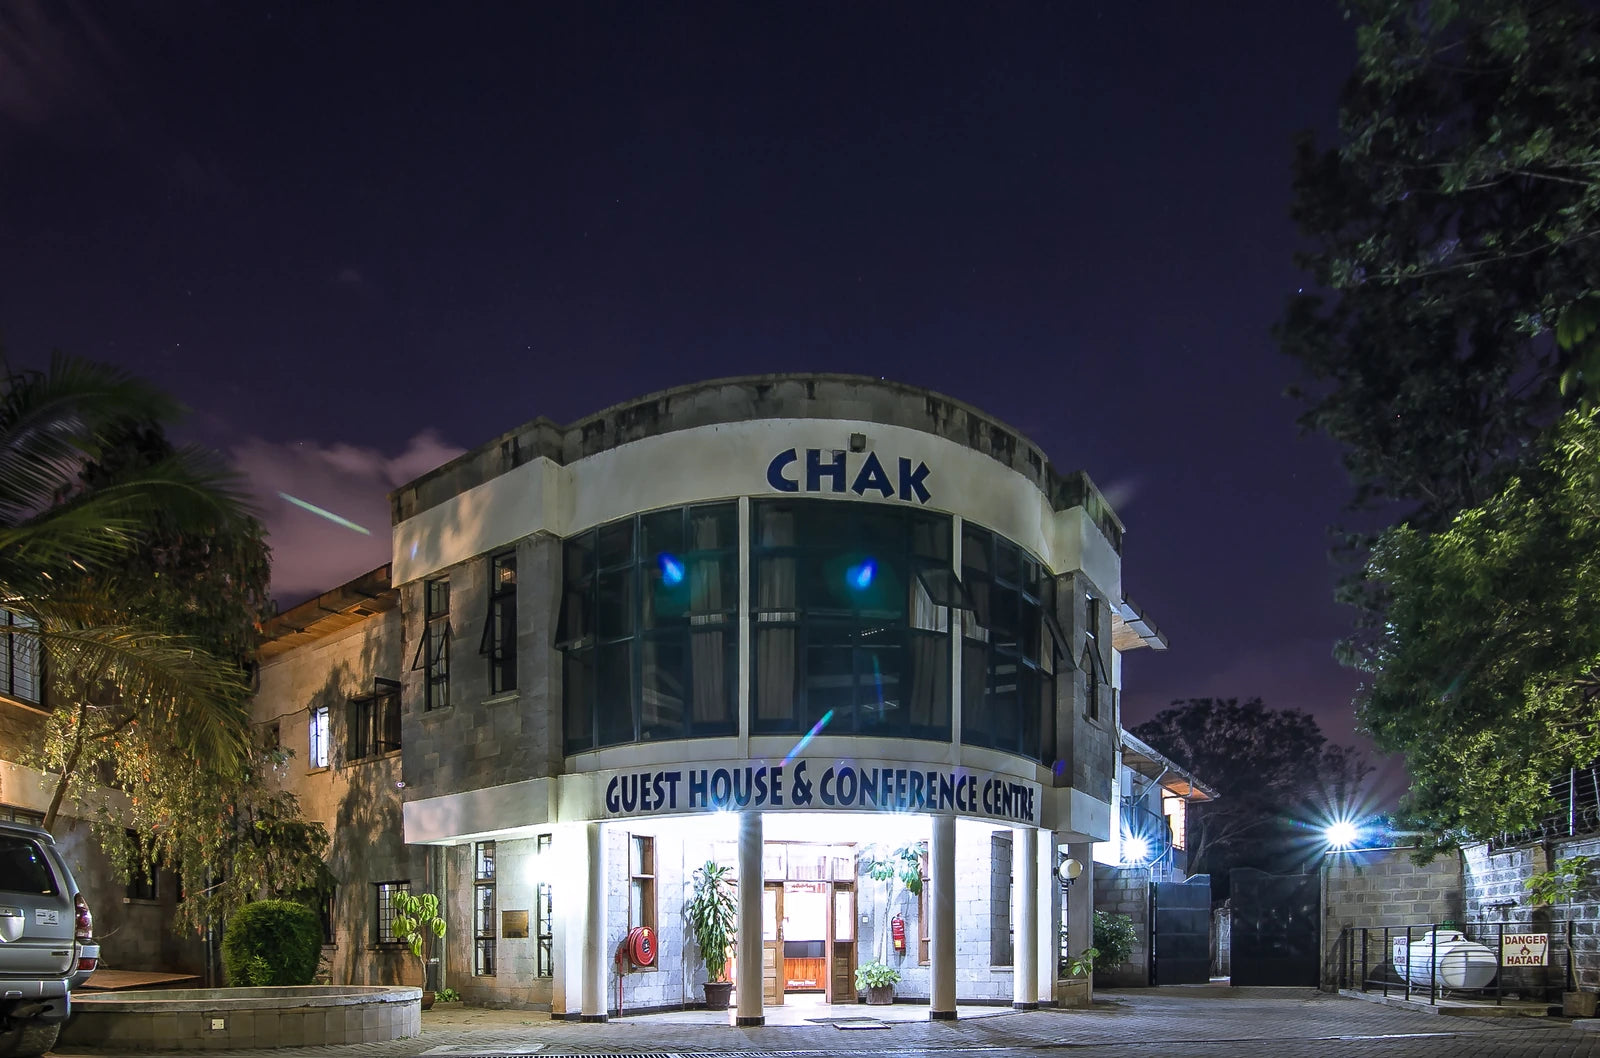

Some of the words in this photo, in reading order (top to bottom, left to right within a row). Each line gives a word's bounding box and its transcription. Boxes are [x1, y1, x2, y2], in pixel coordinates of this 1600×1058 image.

[767, 448, 932, 505] CHAK
[605, 771, 682, 814] GUEST
[688, 766, 784, 808] HOUSE
[791, 760, 813, 806] &
[819, 766, 978, 813] CONFERENCE
[982, 777, 1034, 822] CENTRE
[1504, 936, 1547, 945] DANGER
[1507, 956, 1543, 965] HATARI
